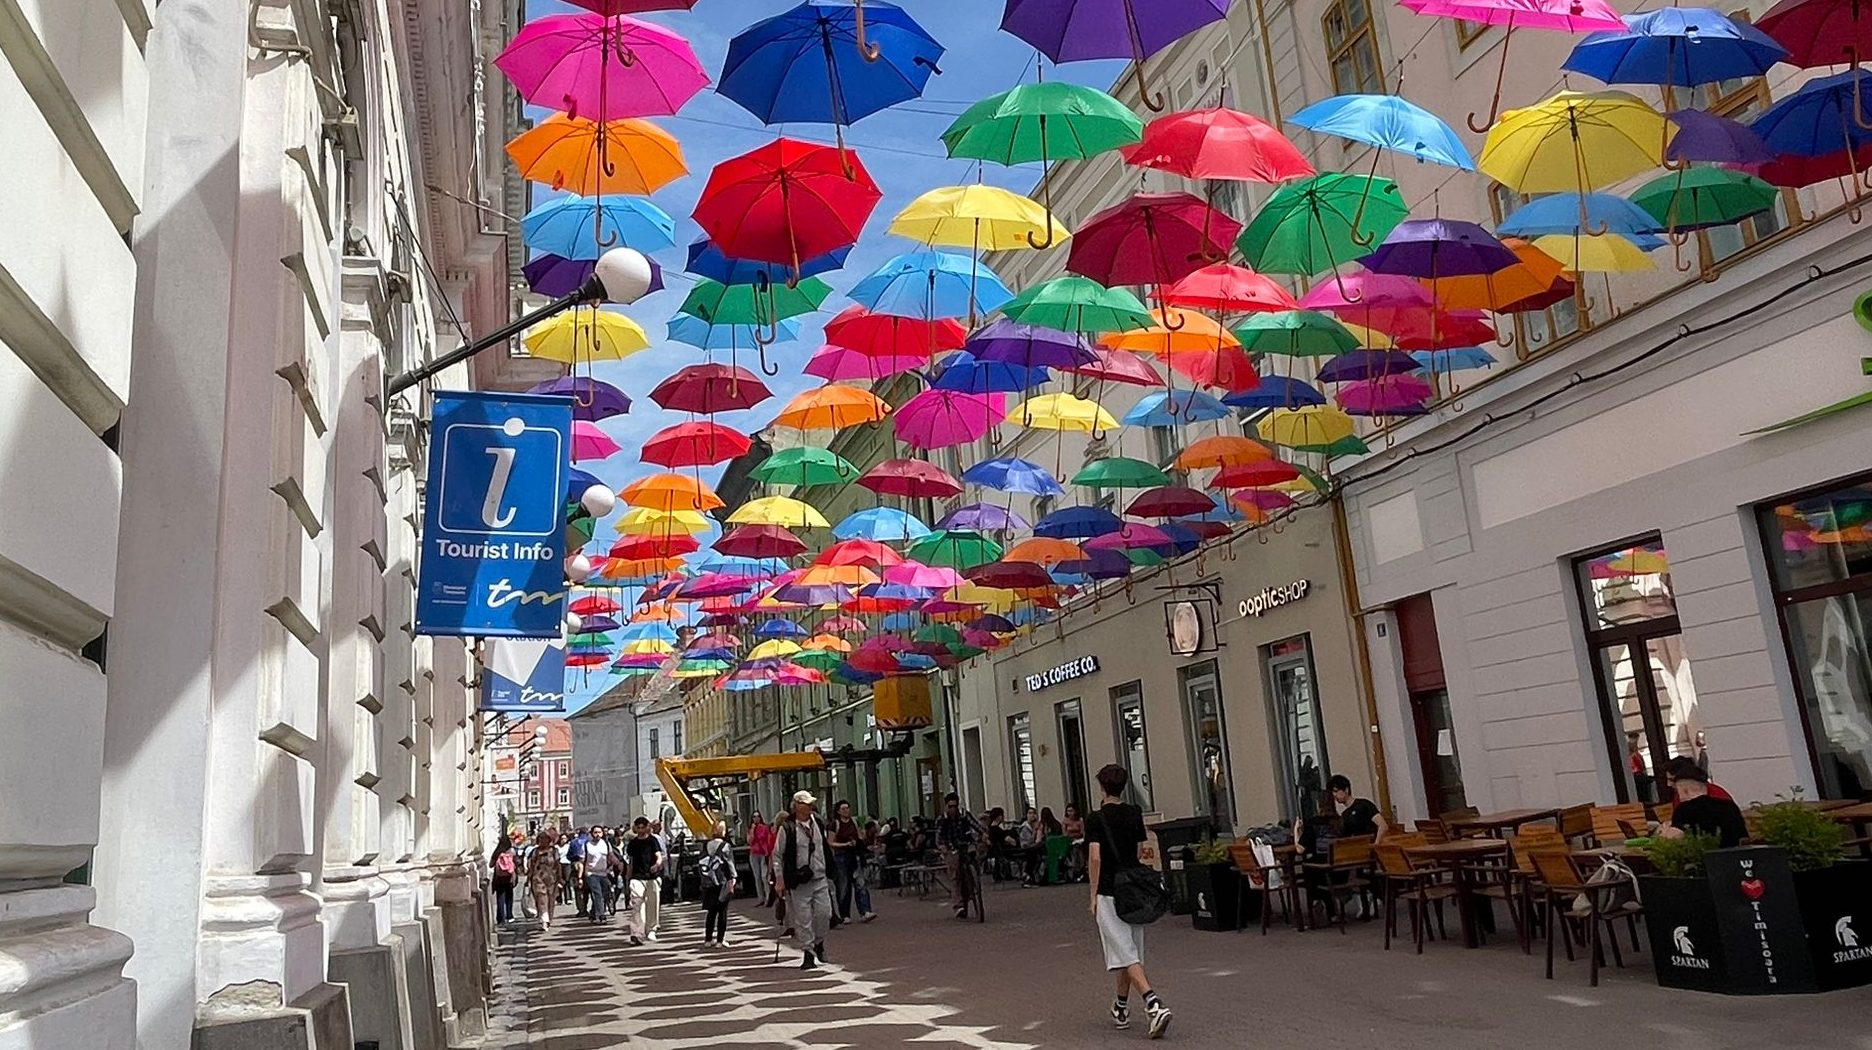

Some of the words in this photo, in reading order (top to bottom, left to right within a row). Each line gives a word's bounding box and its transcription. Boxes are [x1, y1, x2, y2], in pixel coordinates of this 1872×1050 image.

[436, 539, 509, 560] Tourist
[514, 542, 554, 561] Info
[1049, 660, 1081, 684] COFFEE
[1740, 860, 1753, 877] We
[1671, 955, 1710, 969] SPARTAN
[1833, 945, 1872, 963] SPARTAN
